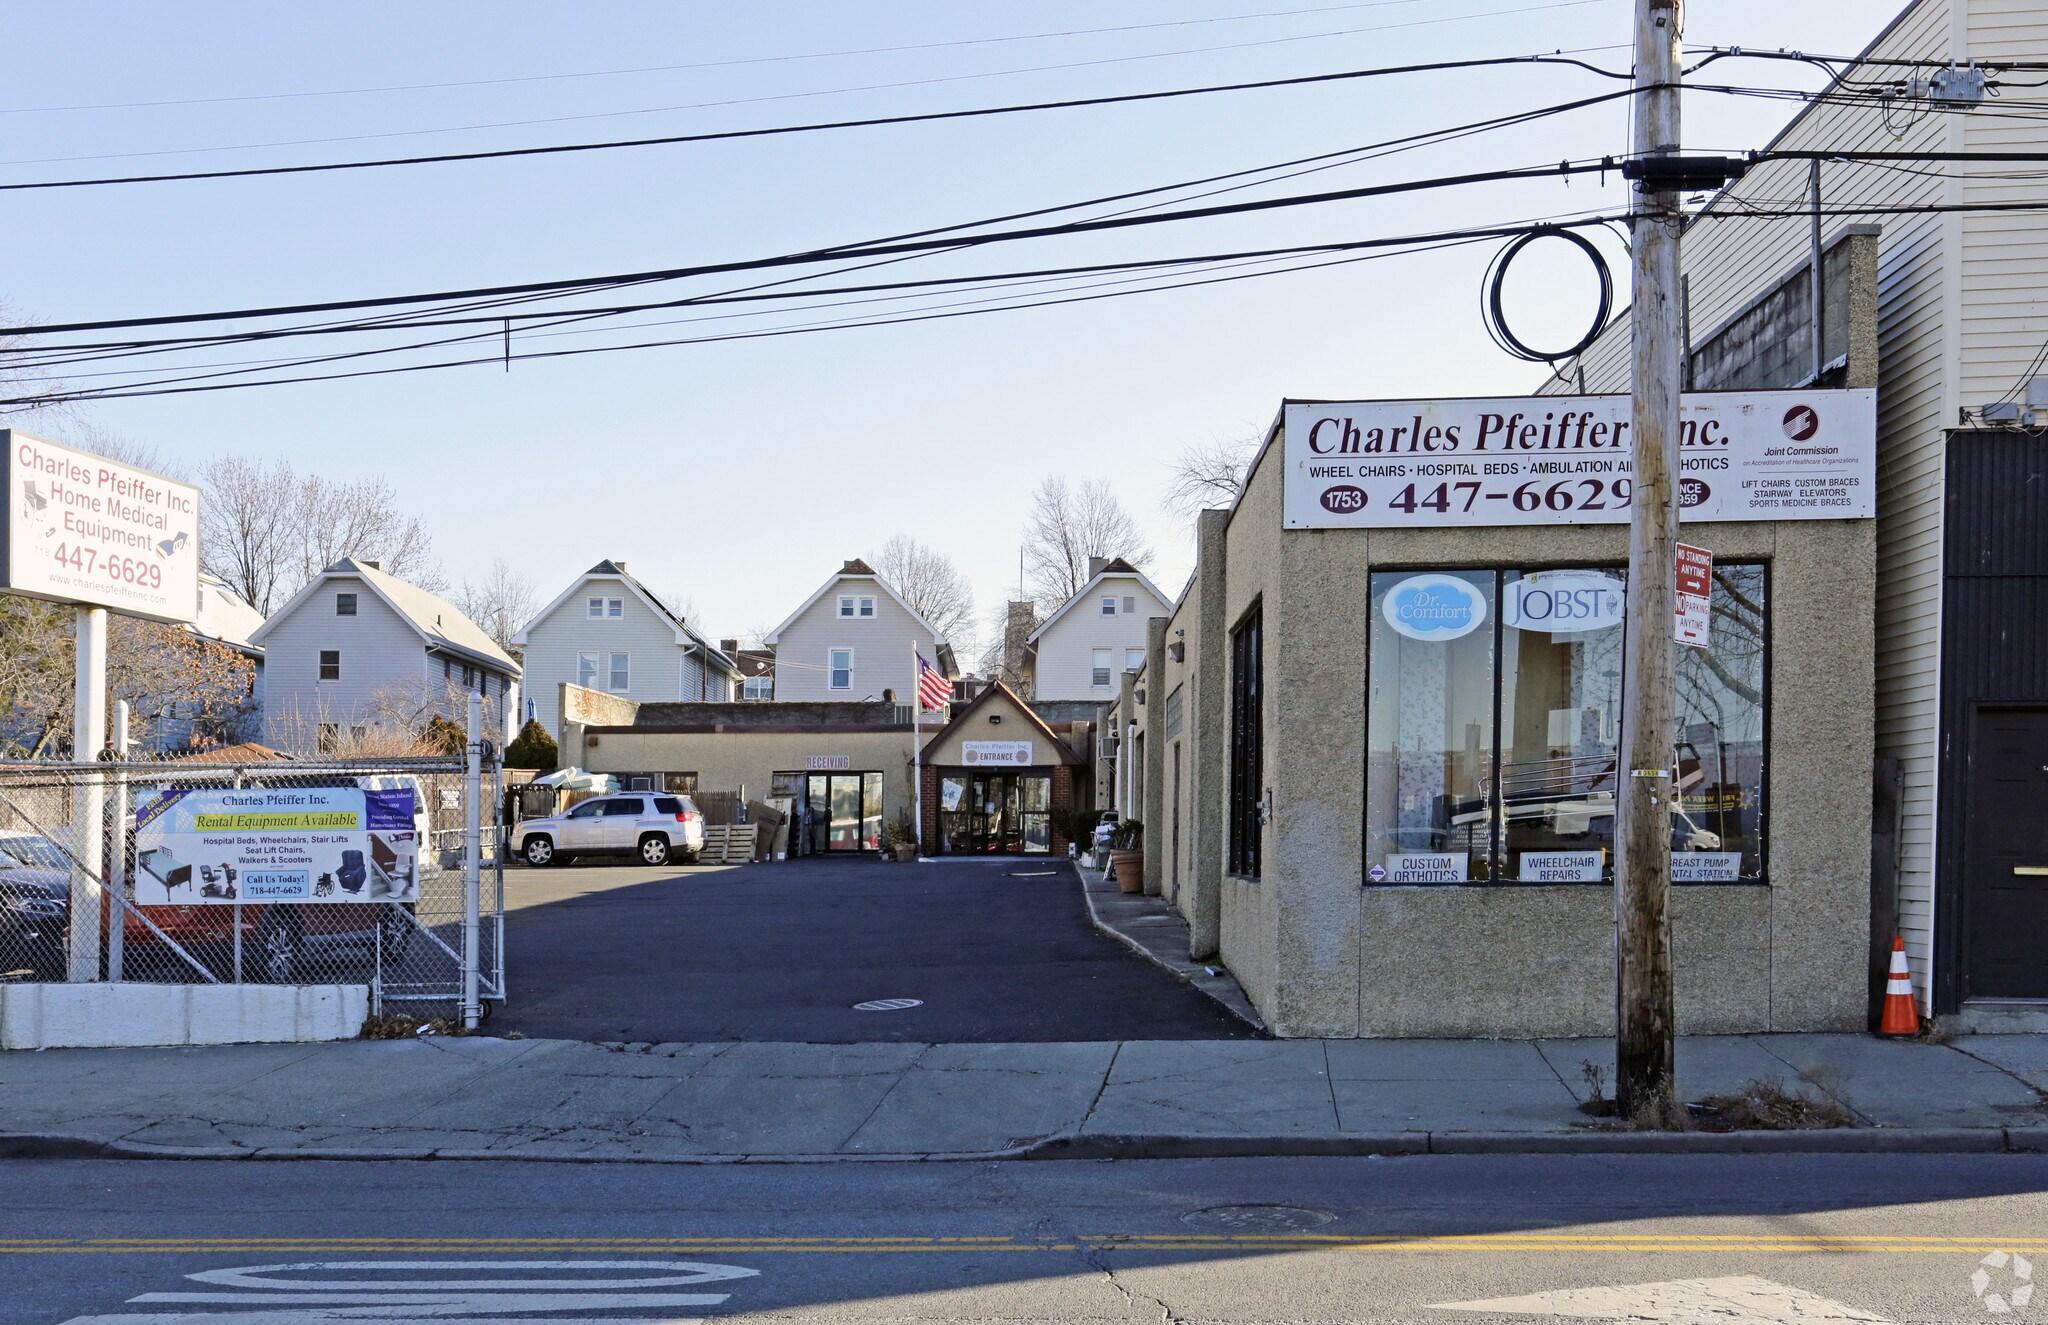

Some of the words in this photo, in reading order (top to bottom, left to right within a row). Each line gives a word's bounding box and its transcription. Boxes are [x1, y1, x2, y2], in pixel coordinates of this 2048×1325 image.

[1309, 416, 1461, 454] Charles
[1472, 412, 1629, 450] Pfeiffer
[1680, 420, 1729, 446] nc.
[1764, 447, 1785, 456] Joint
[1787, 446, 1839, 456] Commission
[1822, 457, 1859, 466] Organizations
[1310, 467, 1353, 478] WHEEL
[1359, 465, 1406, 477] CHAIRS
[1417, 464, 1478, 476] HOSPITAL
[1484, 462, 1519, 475] BEDS
[1530, 461, 1612, 474] AMBULATION
[1681, 458, 1729, 471] HOTICS
[19, 444, 91, 485] Charles
[98, 469, 161, 505] Pfeiffer
[168, 489, 193, 515] Inc.
[1742, 480, 1758, 488] LIFT
[1761, 479, 1791, 487] CHAIRS
[1794, 479, 1826, 487] CUSTOM
[1829, 478, 1860, 486] BRACES
[1680, 483, 1702, 494] NCE
[1754, 489, 1793, 498] STAIRWAY
[1800, 488, 1846, 497] ELEVATORS
[1327, 491, 1362, 508] 1753
[1389, 479, 1631, 514] 447-6629
[1679, 494, 1699, 505] 959
[51, 480, 101, 512] Home
[107, 496, 167, 531] Medical
[1749, 499, 1779, 508] SPORTS
[1782, 499, 1818, 507] MEDICINE
[1821, 498, 1852, 506] BRACES
[64, 511, 152, 551] Equipment
[1678, 549, 1685, 560] NO
[1686, 550, 1710, 566] STANDING
[54, 541, 161, 590] 447-6629
[1681, 564, 1705, 578] ANYTIME
[1414, 592, 1439, 606] Dr.
[1511, 584, 1607, 625] JOBST
[1675, 594, 1685, 612] NO
[1686, 601, 1708, 615] PARKING
[1401, 604, 1468, 619] Comfort
[1680, 618, 1704, 631] ANYTIME
[807, 757, 849, 769] RECEIVING
[222, 796, 264, 806] Charles
[266, 795, 306, 805] Pfeiffer
[309, 794, 330, 804] Inc.
[137, 811, 157, 829] Local
[155, 792, 181, 815] Delivery
[197, 815, 234, 828] Rental
[237, 814, 298, 830] Equipment
[301, 813, 357, 826] Available
[203, 837, 235, 846] Hospital
[237, 837, 258, 846] Beds,
[260, 836, 309, 845] Wheelchairs,
[311, 835, 329, 843] Stair
[331, 835, 349, 843] Lifts
[264, 846, 277, 854] Lift
[278, 845, 306, 855] Chairs,
[238, 856, 269, 864] Walkers
[278, 855, 312, 864] Scooters
[1402, 858, 1451, 869] CUSTOM
[1528, 857, 1595, 868] WHEELCHAIR
[1671, 858, 1701, 867] REAST
[1704, 858, 1729, 867] PUMP
[1394, 870, 1459, 882] ORTHOTICS
[1540, 869, 1581, 880] REPAIRS
[1671, 870, 1692, 878] NTAL
[1697, 869, 1733, 878] STATION
[247, 876, 263, 884] Call
[265, 876, 276, 884] Us
[278, 875, 305, 886] Today!
[250, 886, 302, 896] 718-447-6629
